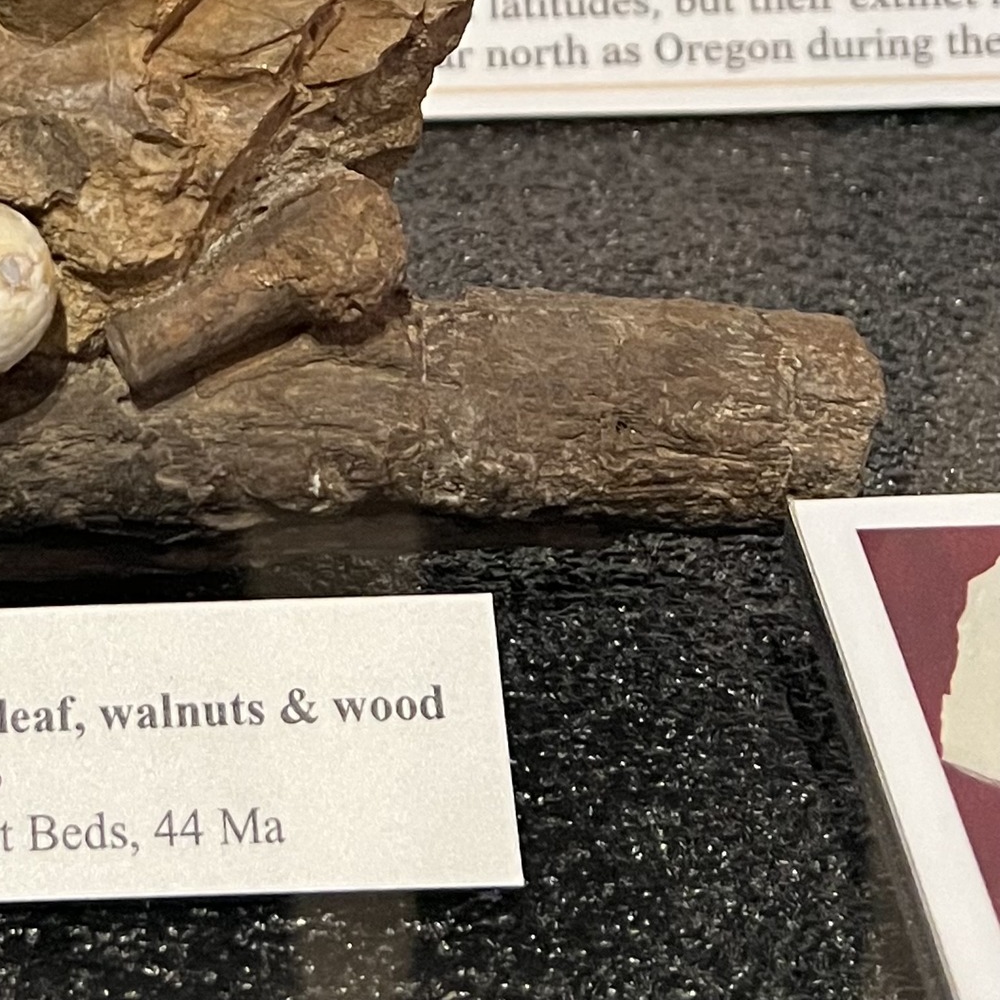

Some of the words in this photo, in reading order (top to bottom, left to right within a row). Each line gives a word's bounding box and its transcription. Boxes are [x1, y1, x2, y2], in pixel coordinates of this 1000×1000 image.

[487, 34, 589, 68] north
[603, 43, 641, 66] as
[654, 33, 795, 70] Oregon
[807, 25, 933, 67] during
[99, 693, 264, 730] walnuts
[281, 688, 318, 724] &
[333, 685, 445, 722] wood
[27, 812, 139, 856] Beds,
[154, 809, 203, 846] 44
[219, 807, 285, 845] Ma
